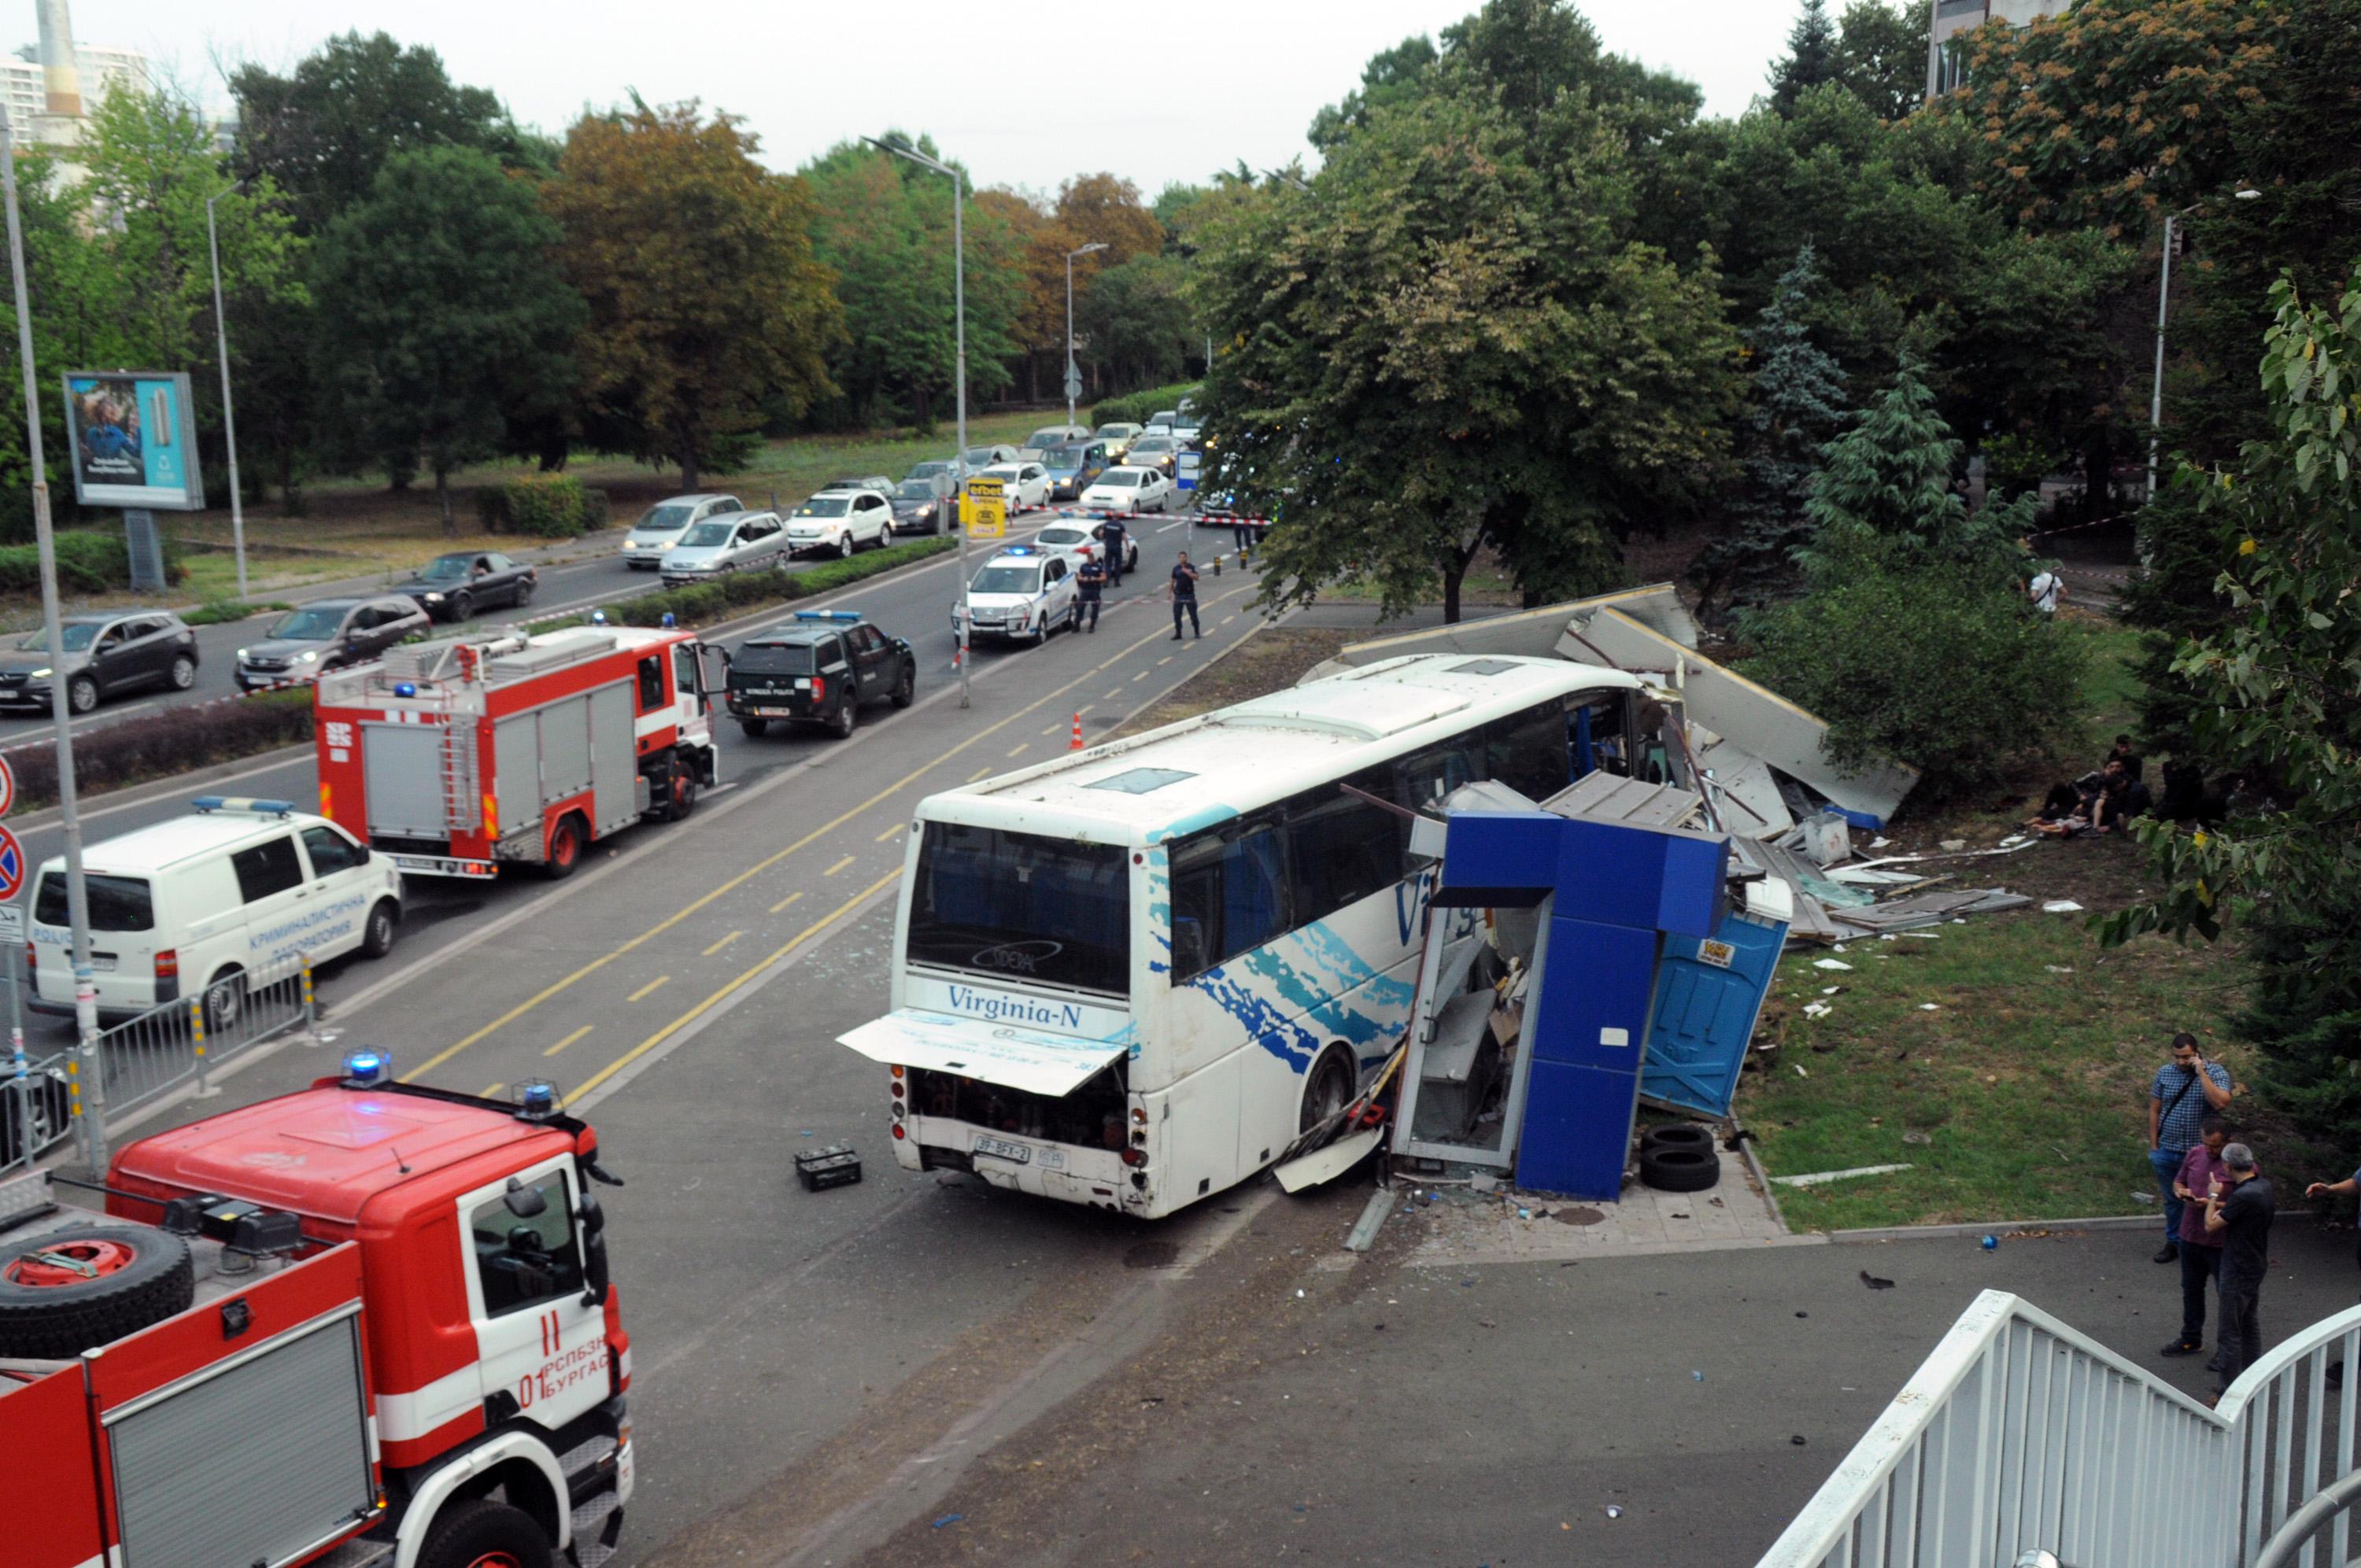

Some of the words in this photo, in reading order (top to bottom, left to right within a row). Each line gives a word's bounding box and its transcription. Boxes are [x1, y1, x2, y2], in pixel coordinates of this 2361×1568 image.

[970, 485, 1002, 495] efbet
[33, 928, 73, 944] POLIC
[948, 984, 1082, 1028] Virginia-N
[545, 1353, 610, 1398] БУРГАС
